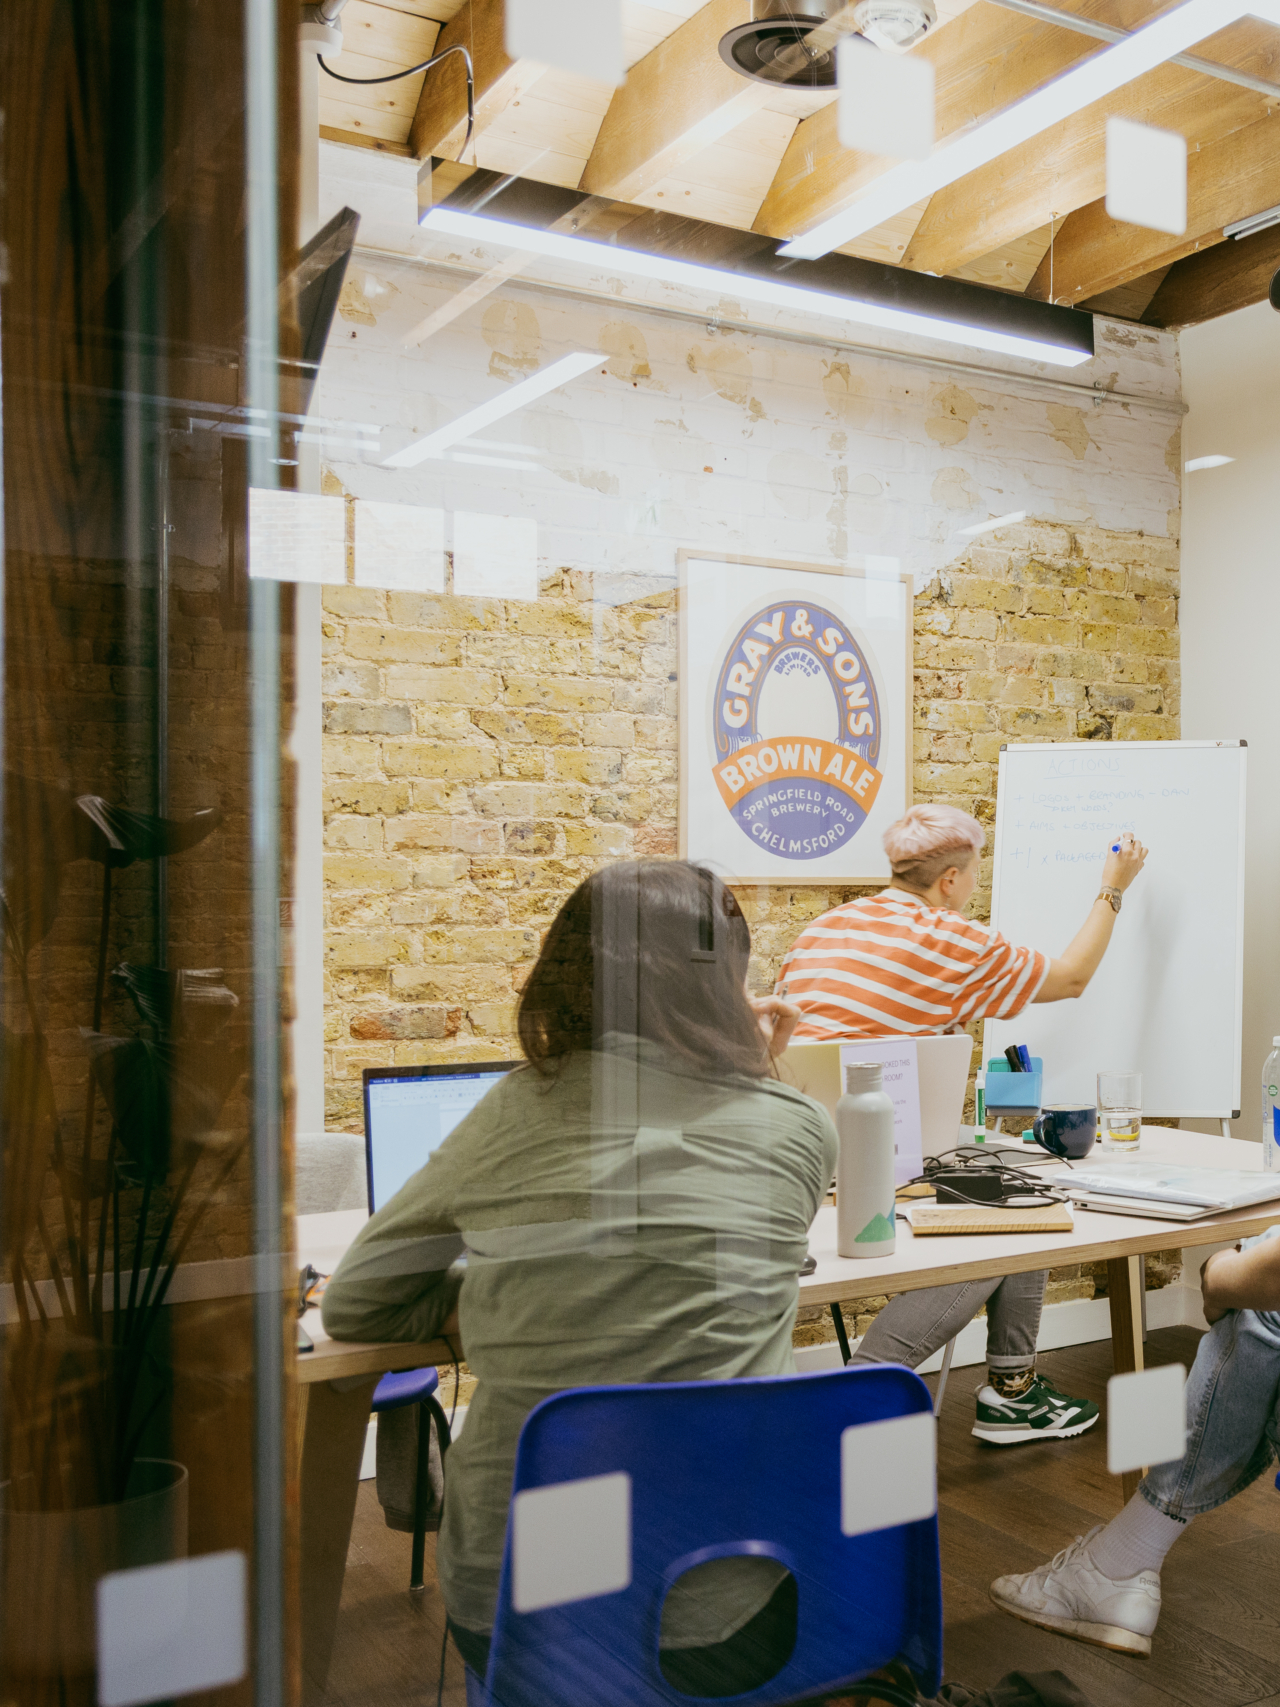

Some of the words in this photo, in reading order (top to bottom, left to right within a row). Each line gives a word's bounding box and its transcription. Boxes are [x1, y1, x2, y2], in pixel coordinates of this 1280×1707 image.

[773, 651, 821, 675] BREWERS
[784, 663, 812, 678] LIMITED
[722, 610, 787, 729] GRAY
[790, 608, 815, 641] &
[815, 627, 874, 737] SONS
[719, 743, 822, 794] BROWN
[823, 752, 875, 798] ALE
[1046, 757, 1121, 775] ACTIONS
[1032, 792, 1070, 804] LOGOS
[1089, 789, 1145, 801] BRANDING
[1161, 788, 1190, 797] DAN
[742, 789, 822, 821] SPRINGFIELD
[825, 796, 855, 823] ROAD
[770, 802, 829, 818] BREWERY
[1029, 821, 1055, 832] AIMS
[1073, 821, 1136, 832] OBJECTIVES
[751, 822, 846, 854] CHELMSFORD
[899, 1059, 911, 1067] THIS
